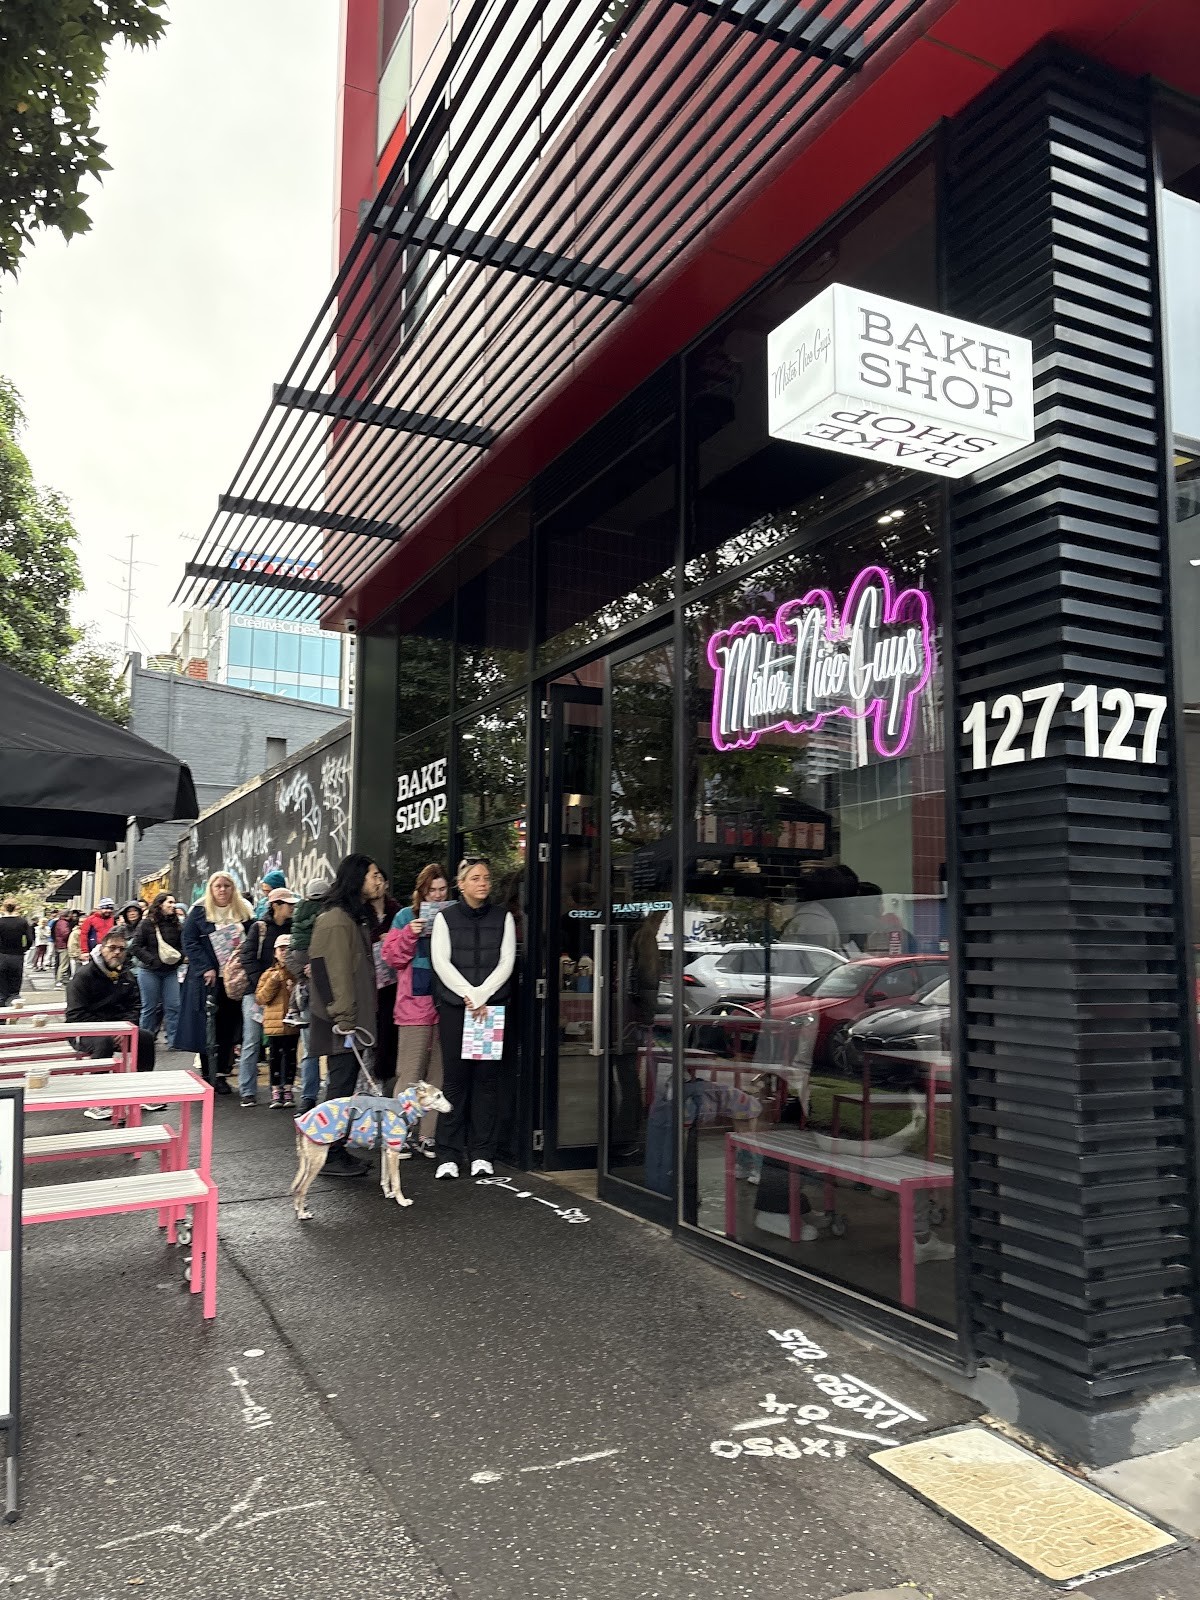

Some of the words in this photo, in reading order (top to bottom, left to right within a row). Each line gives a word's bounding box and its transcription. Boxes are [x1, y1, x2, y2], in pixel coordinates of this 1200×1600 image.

[796, 342, 813, 376] Nice
[857, 306, 1011, 380] BAKE
[858, 352, 1013, 417] SHOP
[801, 422, 969, 469] BAKE
[831, 409, 998, 455] SHOP
[716, 632, 795, 735] Mister
[786, 607, 849, 715] Nice
[962, 682, 1065, 770] 127
[1071, 684, 1168, 764] 127
[397, 757, 448, 802] BAKE
[396, 793, 447, 834] SHOP
